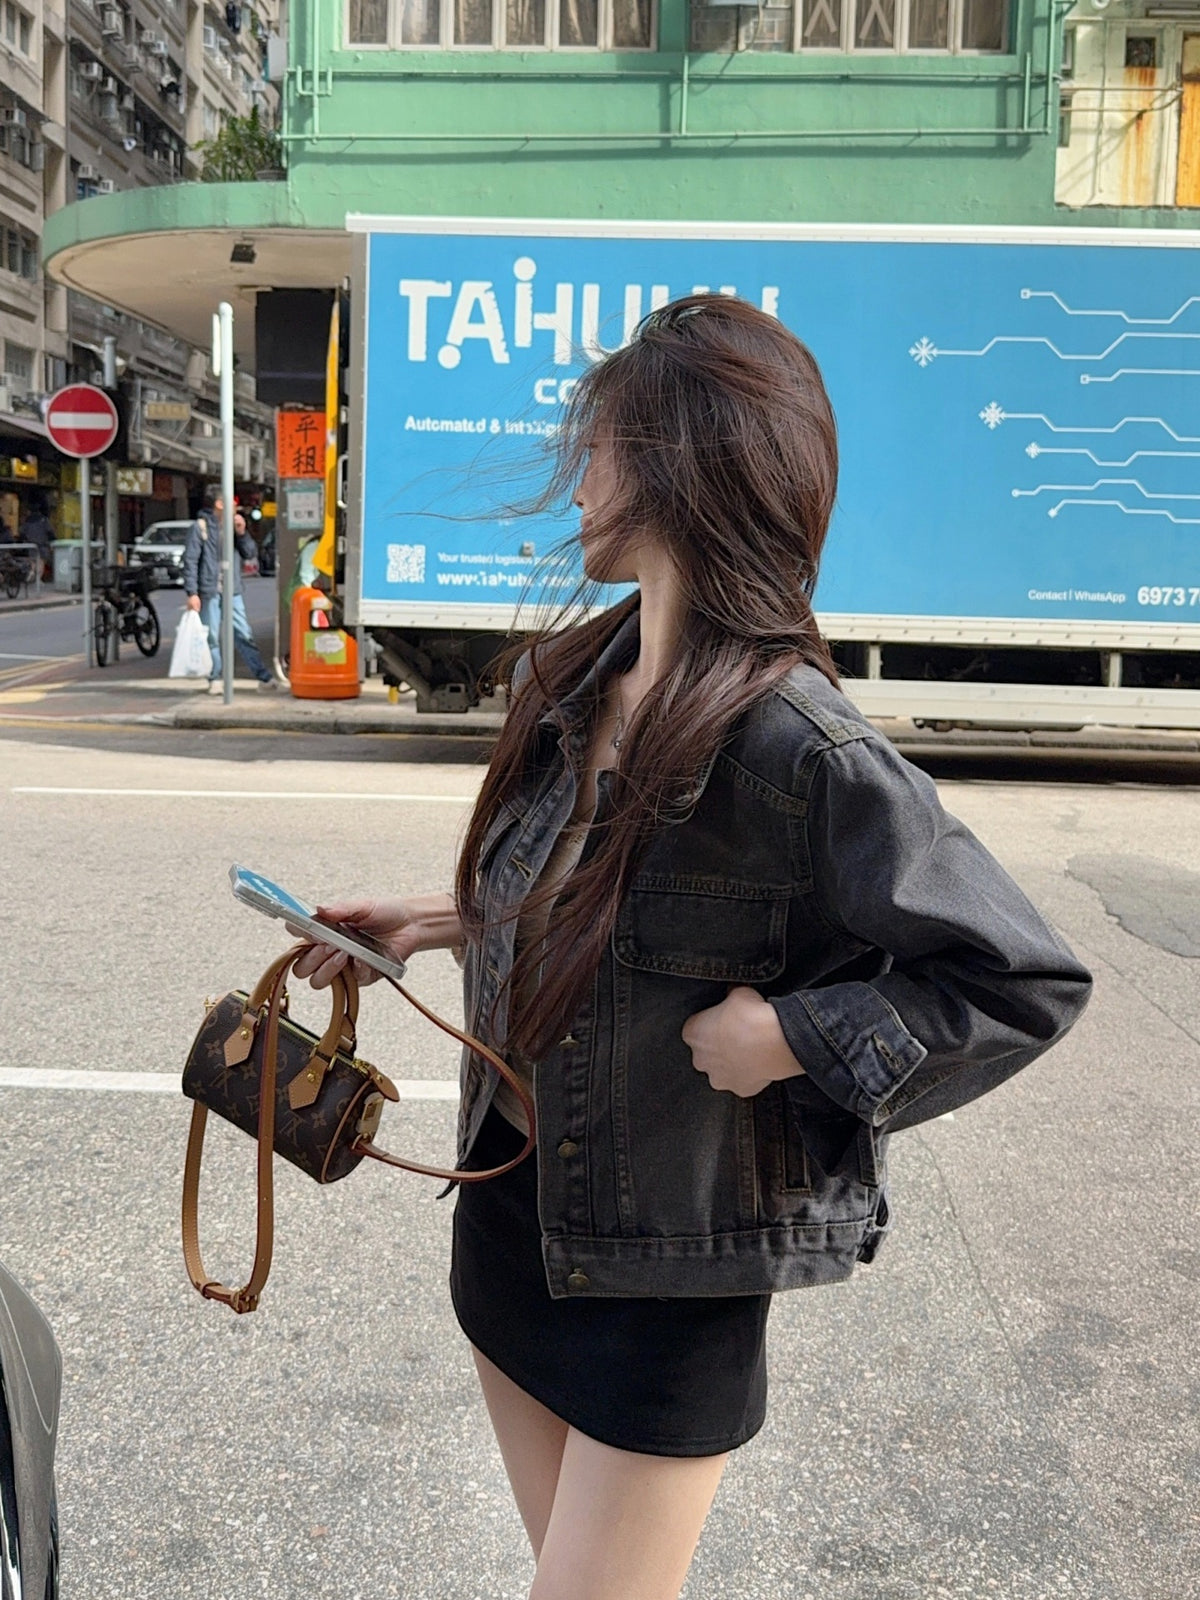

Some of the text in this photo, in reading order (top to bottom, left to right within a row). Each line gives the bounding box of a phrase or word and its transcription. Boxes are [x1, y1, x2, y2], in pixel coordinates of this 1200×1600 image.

[399, 256, 779, 369] TAHU
[404, 416, 486, 433] Automated
[489, 418, 500, 434] &
[292, 414, 320, 475] 平租
[437, 553, 459, 563] Your
[460, 554, 494, 565] trusted
[1028, 590, 1067, 601] Contact
[1074, 590, 1126, 604] WhatsApp
[1137, 586, 1185, 606] 6973
[1187, 588, 1200, 606] 7
